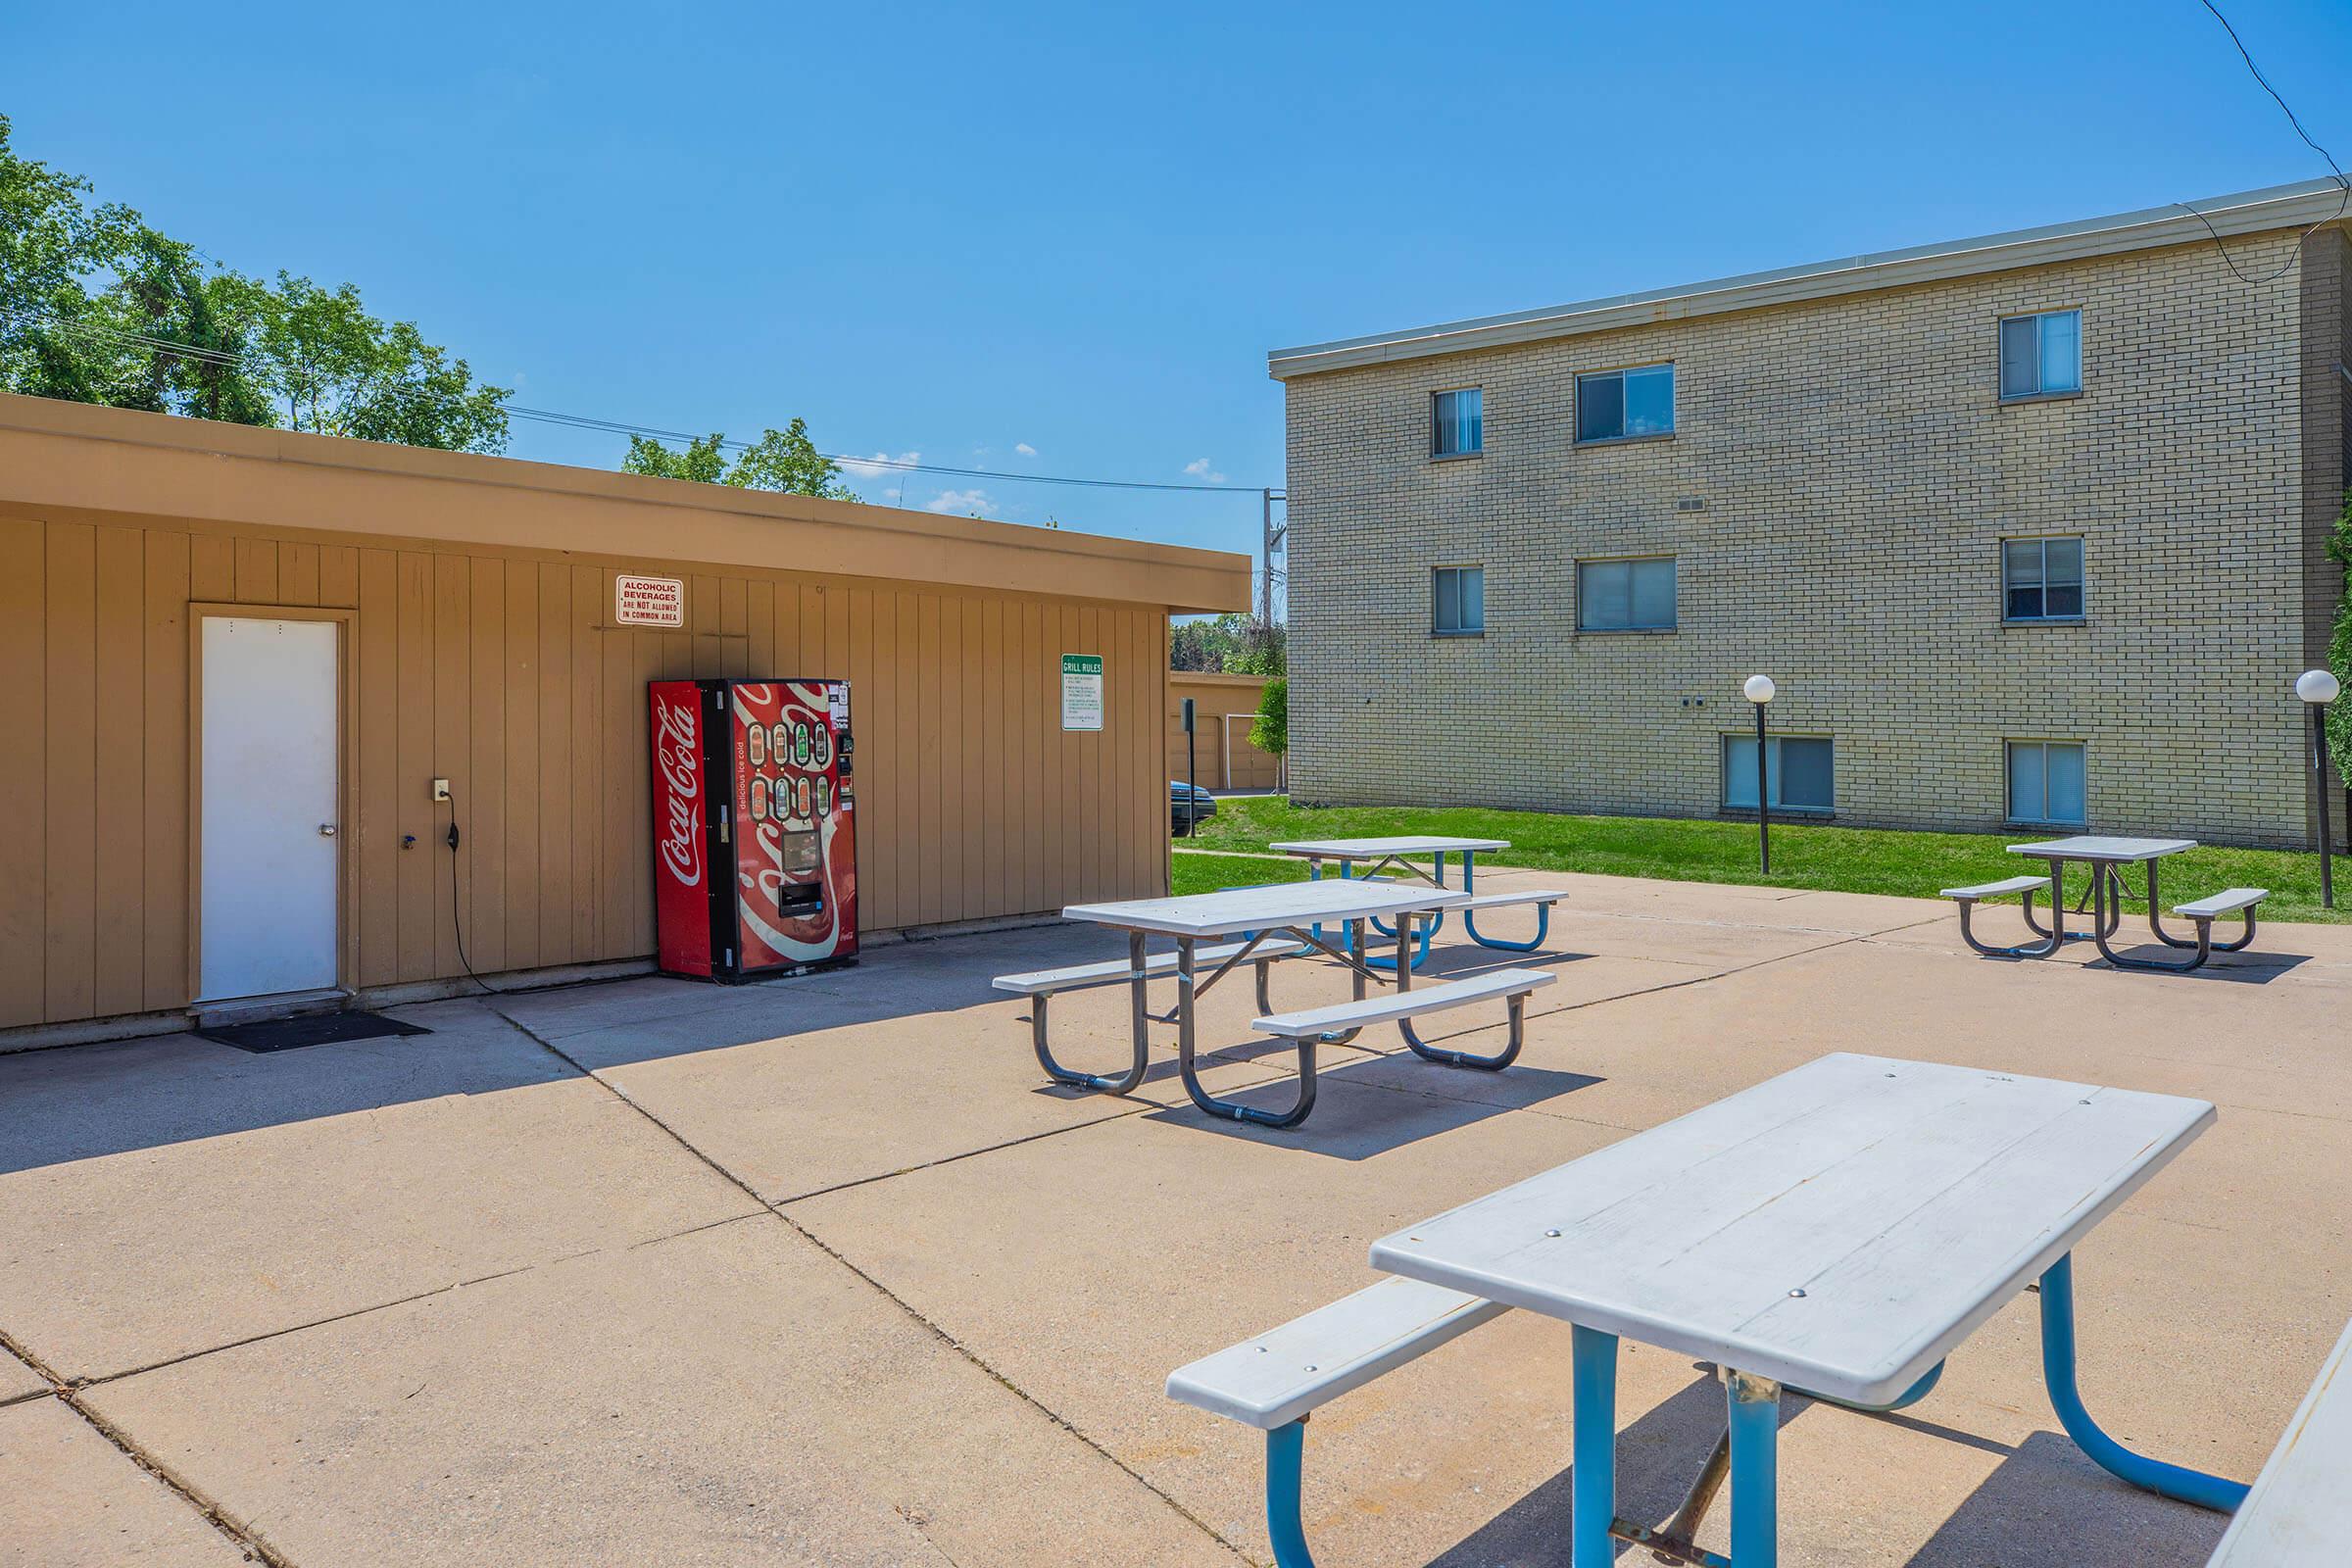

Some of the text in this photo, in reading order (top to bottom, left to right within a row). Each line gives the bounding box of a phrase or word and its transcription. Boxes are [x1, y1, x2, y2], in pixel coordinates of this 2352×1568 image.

[625, 582, 676, 592] ALCOHOLIC
[624, 591, 676, 601] BEVERAGES
[637, 601, 650, 610] NOT
[653, 603, 677, 612] ALLOWED
[632, 612, 659, 620] COMMON
[1064, 662, 1101, 673] GRILL RULES
[737, 760, 746, 773] ice
[657, 693, 701, 887] Coca-Cola
